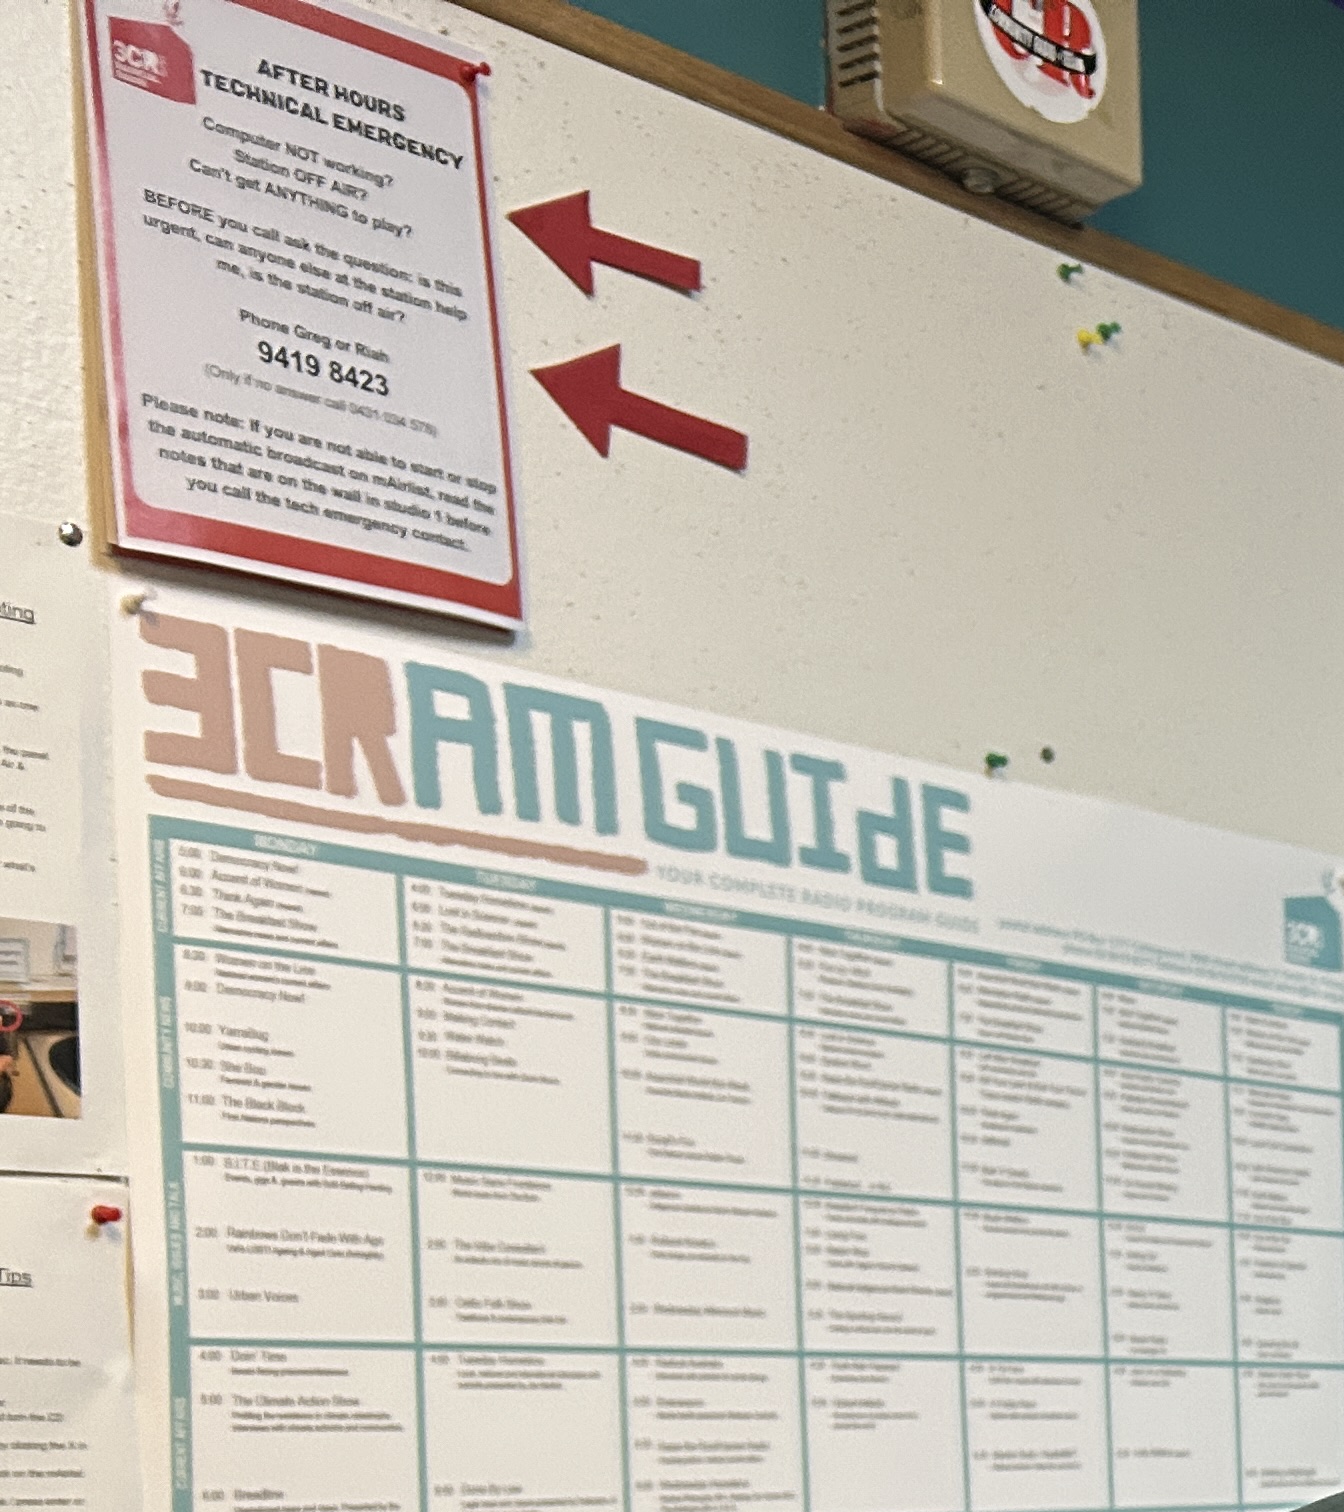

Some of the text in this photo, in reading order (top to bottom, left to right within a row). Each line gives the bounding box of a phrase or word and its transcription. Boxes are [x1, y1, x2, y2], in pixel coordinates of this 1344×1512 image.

[201, 69, 329, 125] TECHNICAL
[332, 113, 465, 170] EMERGENCY
[258, 59, 406, 122] AFTER HOURS
[202, 117, 394, 188] Computer NOT working?
[233, 149, 369, 201] Station OFF AIR?
[188, 158, 413, 238] Can't get ANYTHING to play?
[143, 189, 463, 297] BEFORE you call ask the question: is this
[143, 215, 469, 322] urgent, can anyone else at the station help
[215, 260, 406, 323] me, is the station off air?
[257, 341, 390, 396] 9419 8423
[657, 863, 704, 884] YOUR
[709, 871, 797, 901] COMPLETE
[801, 887, 852, 912] RADIO
